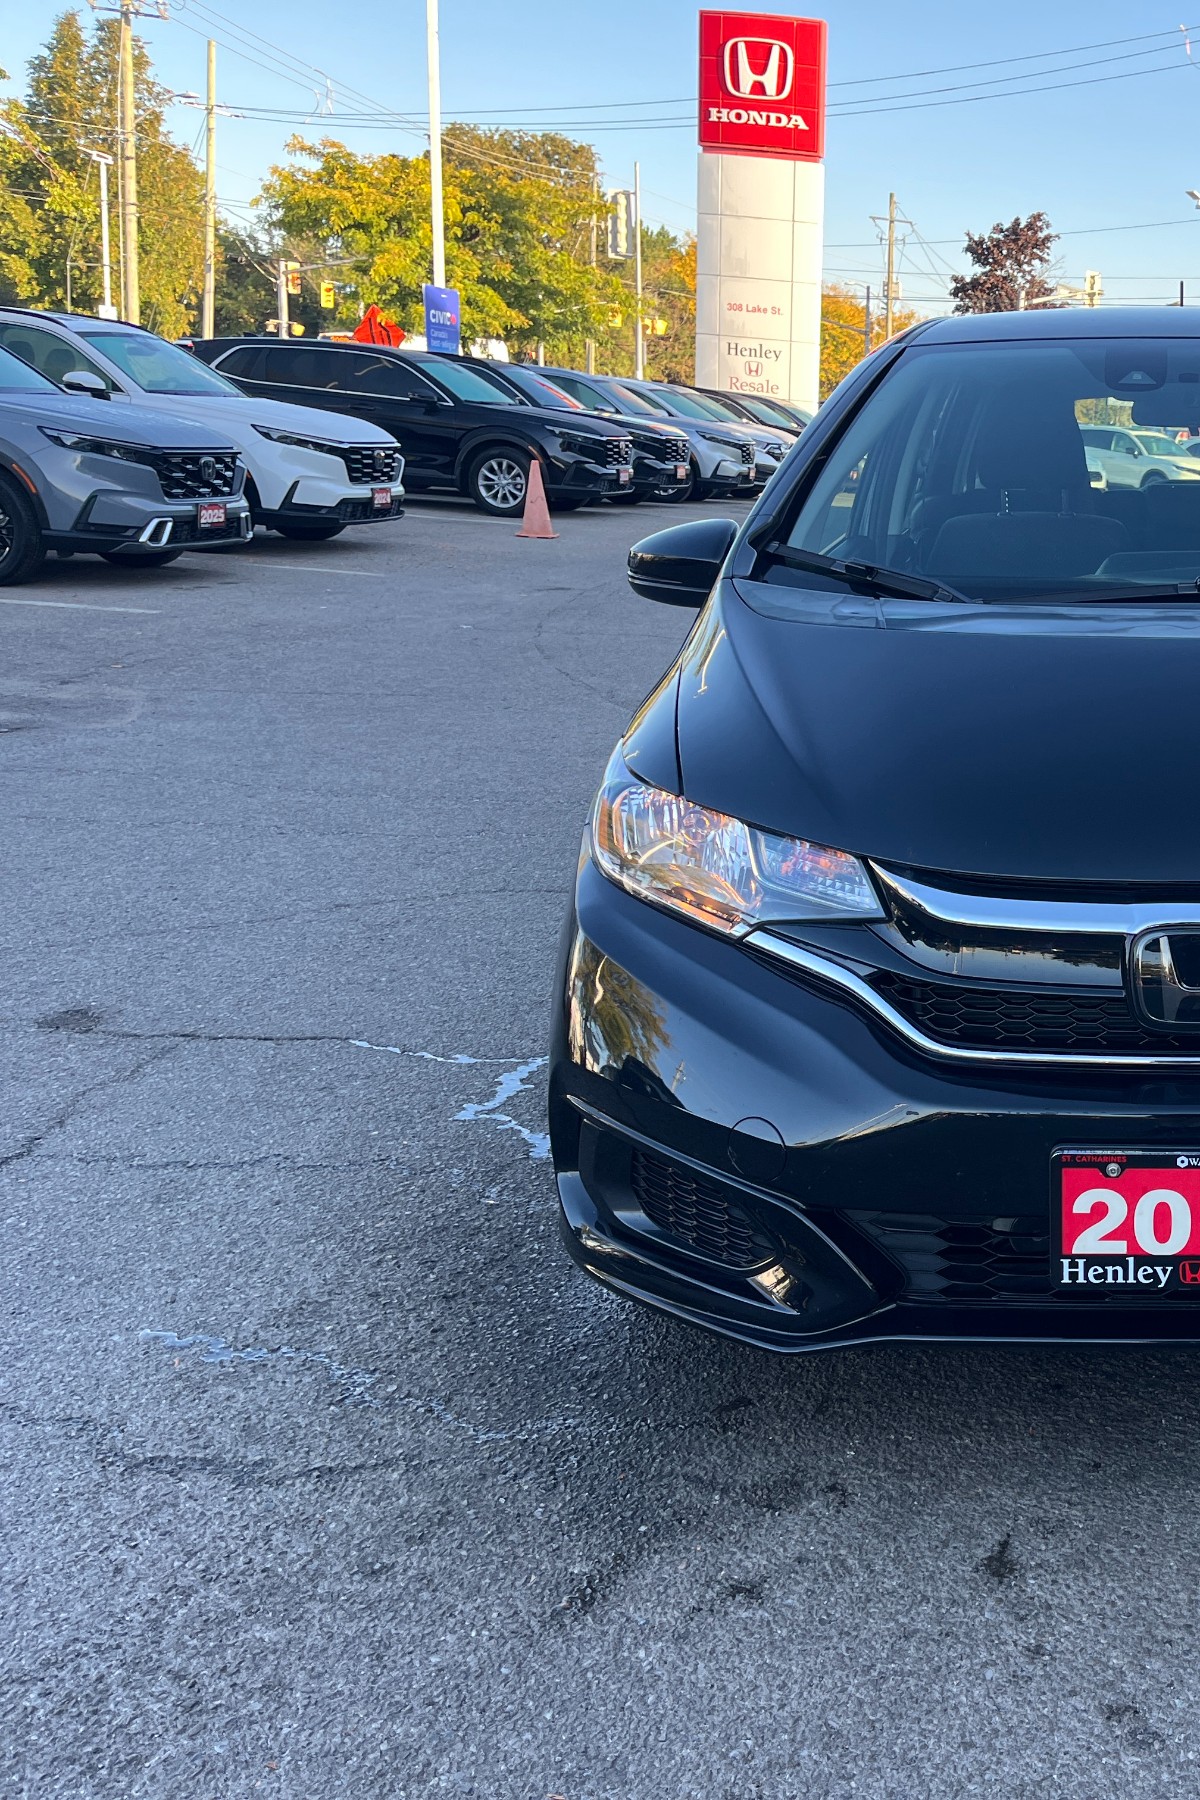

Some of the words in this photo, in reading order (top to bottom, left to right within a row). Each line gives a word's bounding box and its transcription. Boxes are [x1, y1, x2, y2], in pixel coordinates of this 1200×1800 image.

[708, 107, 809, 130] HONDA
[727, 303, 743, 312] 308
[746, 303, 767, 314] Lake
[771, 306, 784, 316] St.
[726, 342, 782, 362] Henley
[729, 376, 779, 394] Resale
[374, 492, 391, 504] 2024
[200, 509, 225, 524] 2025
[1061, 1155, 1073, 1163] ST.
[1075, 1155, 1127, 1163] CATHARINES
[1060, 1257, 1173, 1288] Henley
